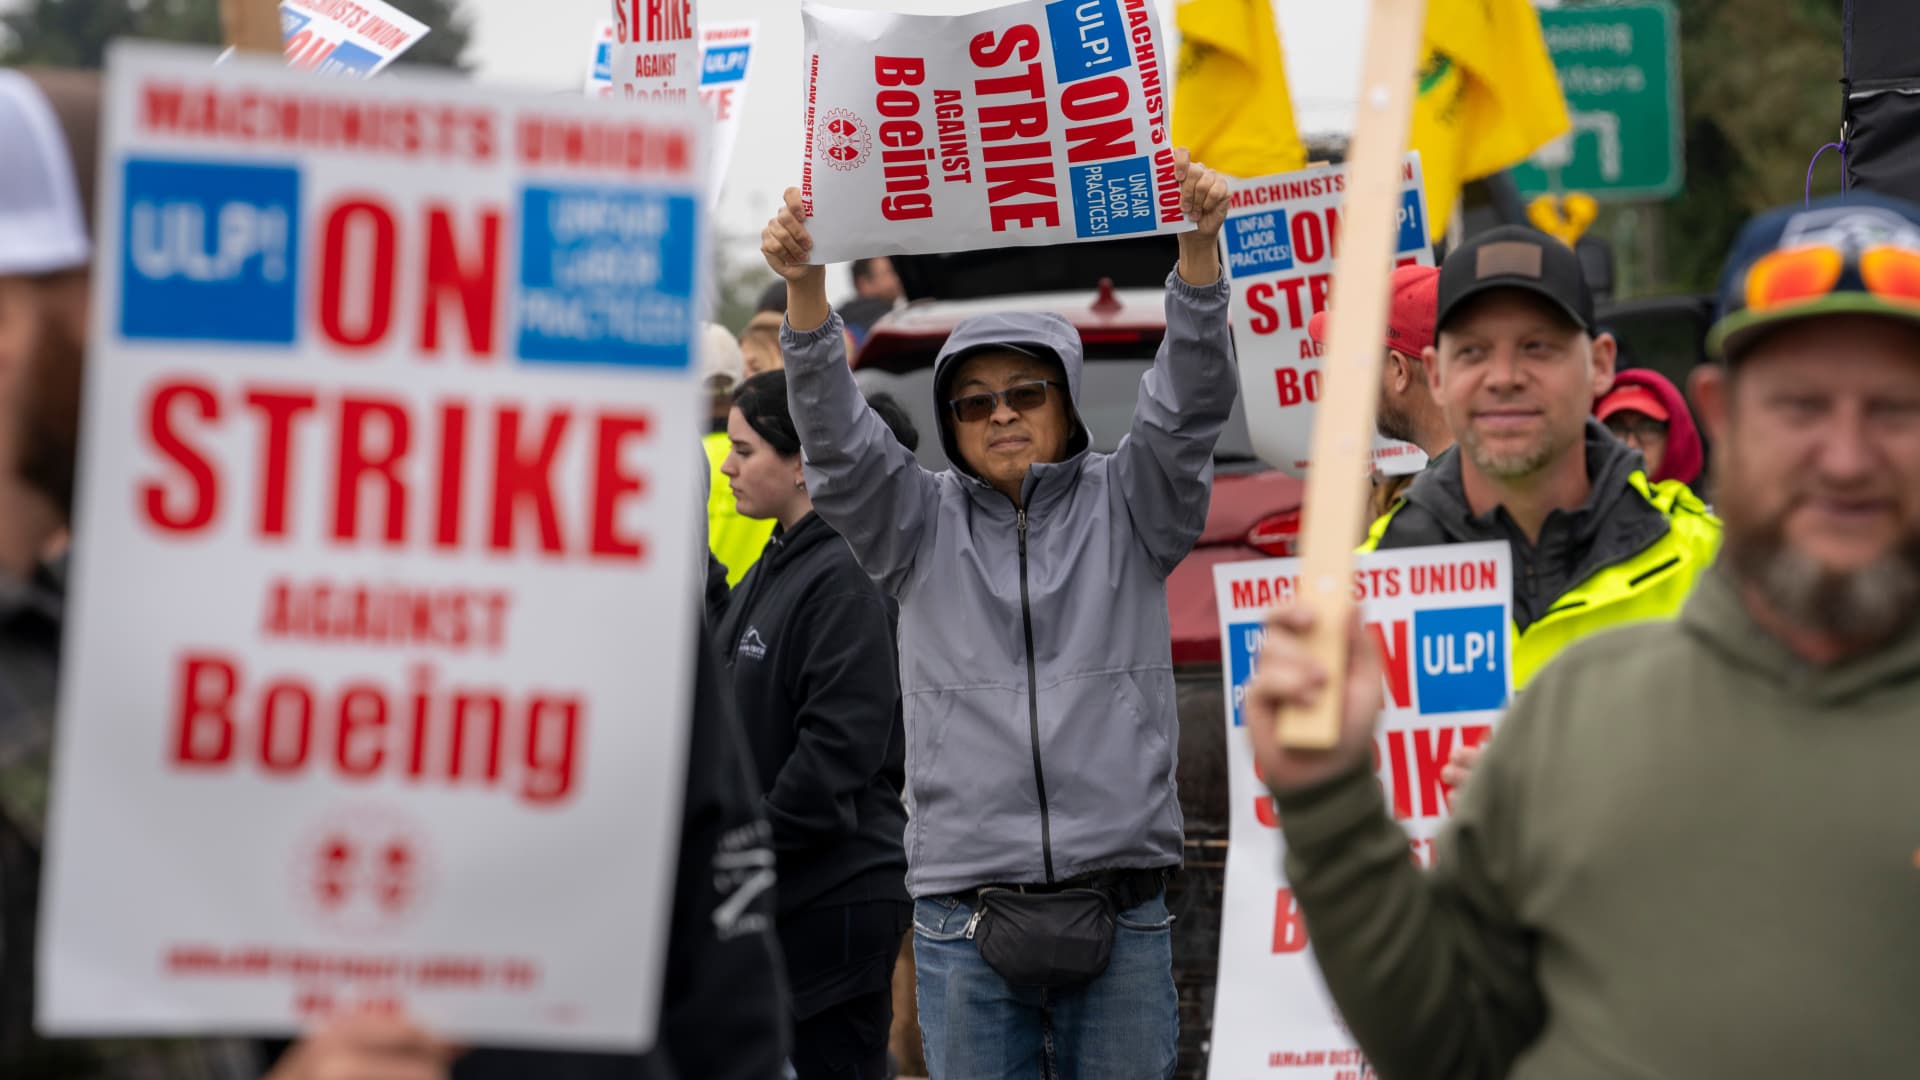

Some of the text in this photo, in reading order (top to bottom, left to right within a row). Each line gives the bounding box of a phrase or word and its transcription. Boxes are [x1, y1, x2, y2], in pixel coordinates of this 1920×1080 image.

[615, 0, 693, 44] STRIKE
[1075, 0, 1113, 68] ULP!
[636, 53, 676, 78] AGAINST
[804, 106, 816, 160] DISTRICT
[874, 55, 934, 222] Boeing
[933, 88, 972, 184] AGAINST
[969, 24, 1060, 232] STRIKE
[1060, 75, 1137, 164] ON
[801, 162, 813, 198] LODGE
[1084, 164, 1110, 235] PRACTICES!
[1107, 178, 1129, 219] LABOR
[1128, 172, 1150, 219] UNFAIR
[1154, 147, 1185, 224] UNION
[1228, 173, 1346, 209] MACHINISTS
[801, 198, 814, 218] 751
[1235, 213, 1275, 234] UNFAIR
[1395, 203, 1417, 231] P!
[132, 201, 287, 281] ULP!
[1230, 245, 1290, 268] PRACTICES!
[1239, 231, 1275, 250] LABOR
[313, 193, 506, 362] ON
[138, 377, 653, 565] STRIKE
[1409, 560, 1497, 596] UNION
[264, 581, 507, 648] AGAINST
[1423, 630, 1496, 676] ULP!
[170, 652, 584, 806] Boeing
